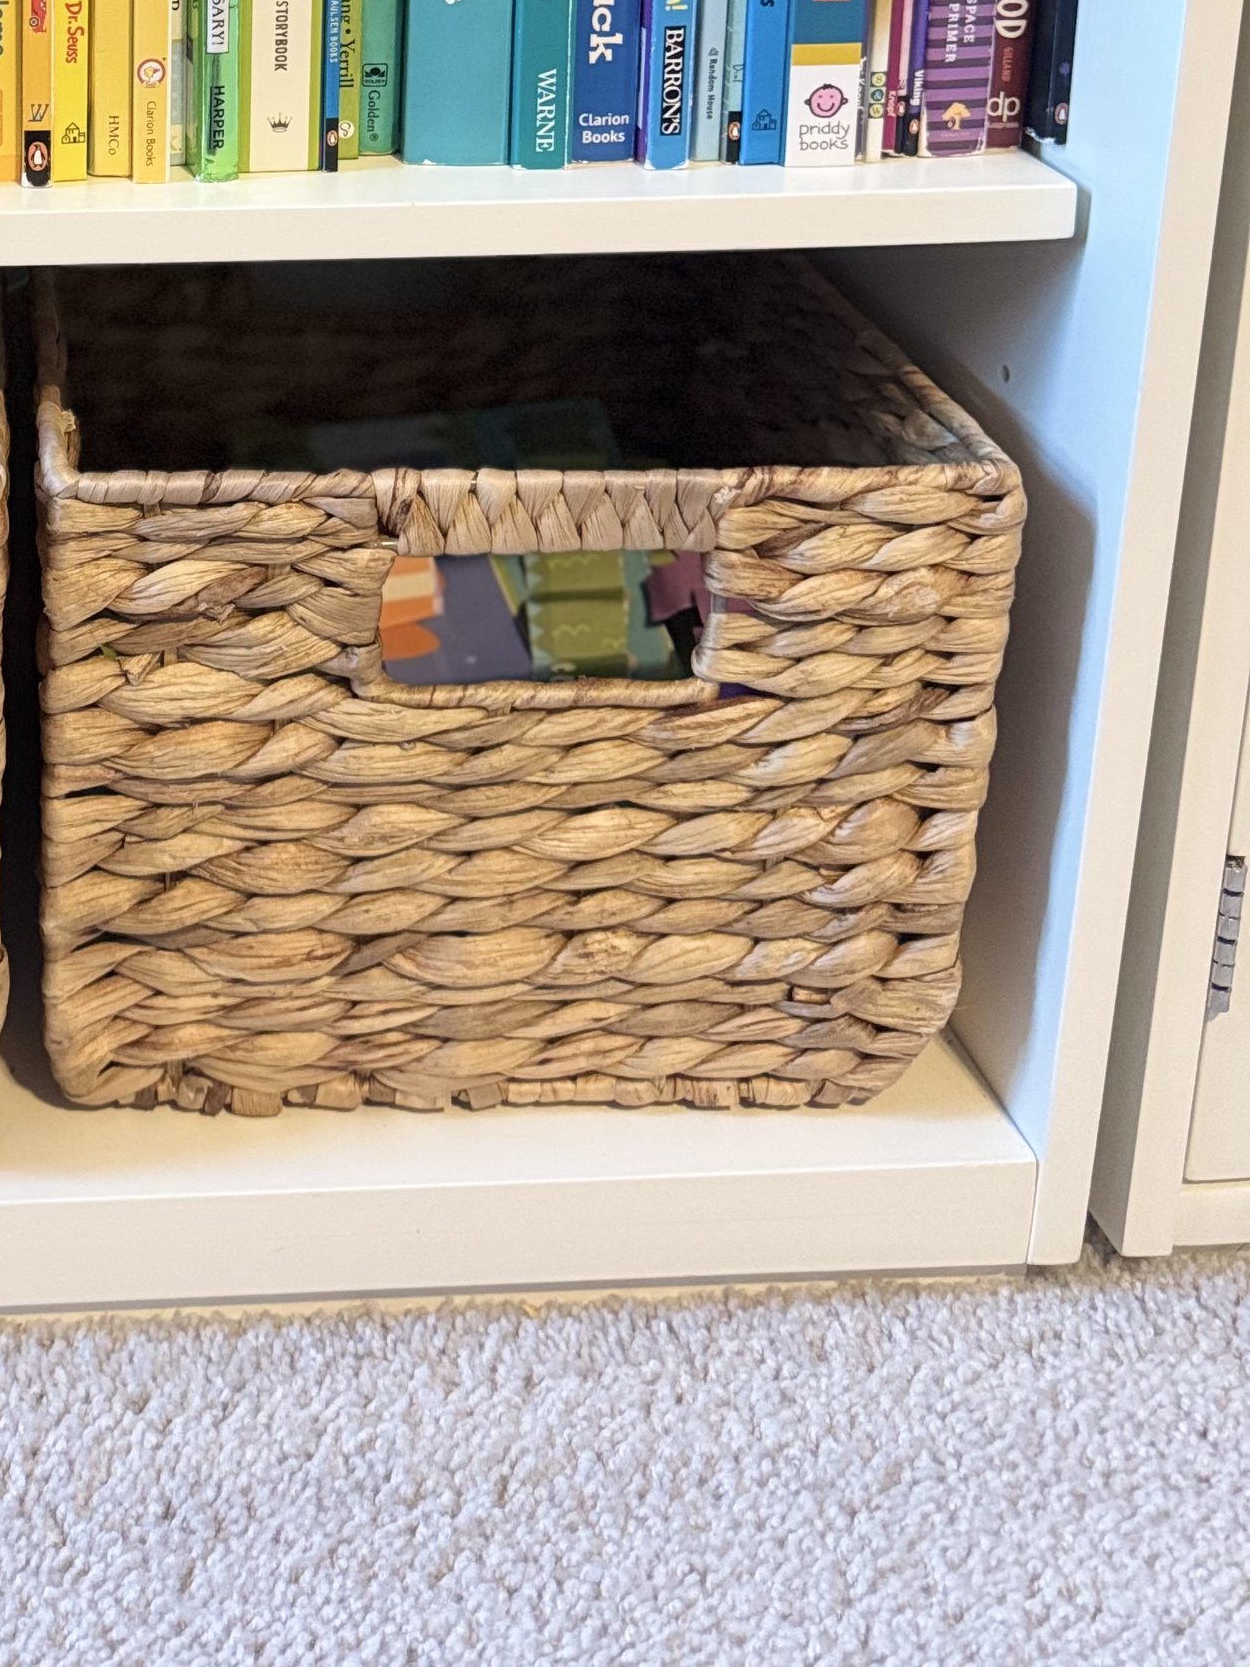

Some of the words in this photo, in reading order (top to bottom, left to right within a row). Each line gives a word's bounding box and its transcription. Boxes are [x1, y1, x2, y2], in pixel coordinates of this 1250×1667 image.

[274, 1, 288, 71] STORYBOOK
[945, 3, 960, 62] PRIMER
[536, 69, 556, 152] WARNE
[662, 28, 684, 134] BARRON'S
[213, 86, 224, 148] HARPER
[578, 113, 629, 127] Clarion
[582, 131, 625, 144] Books
